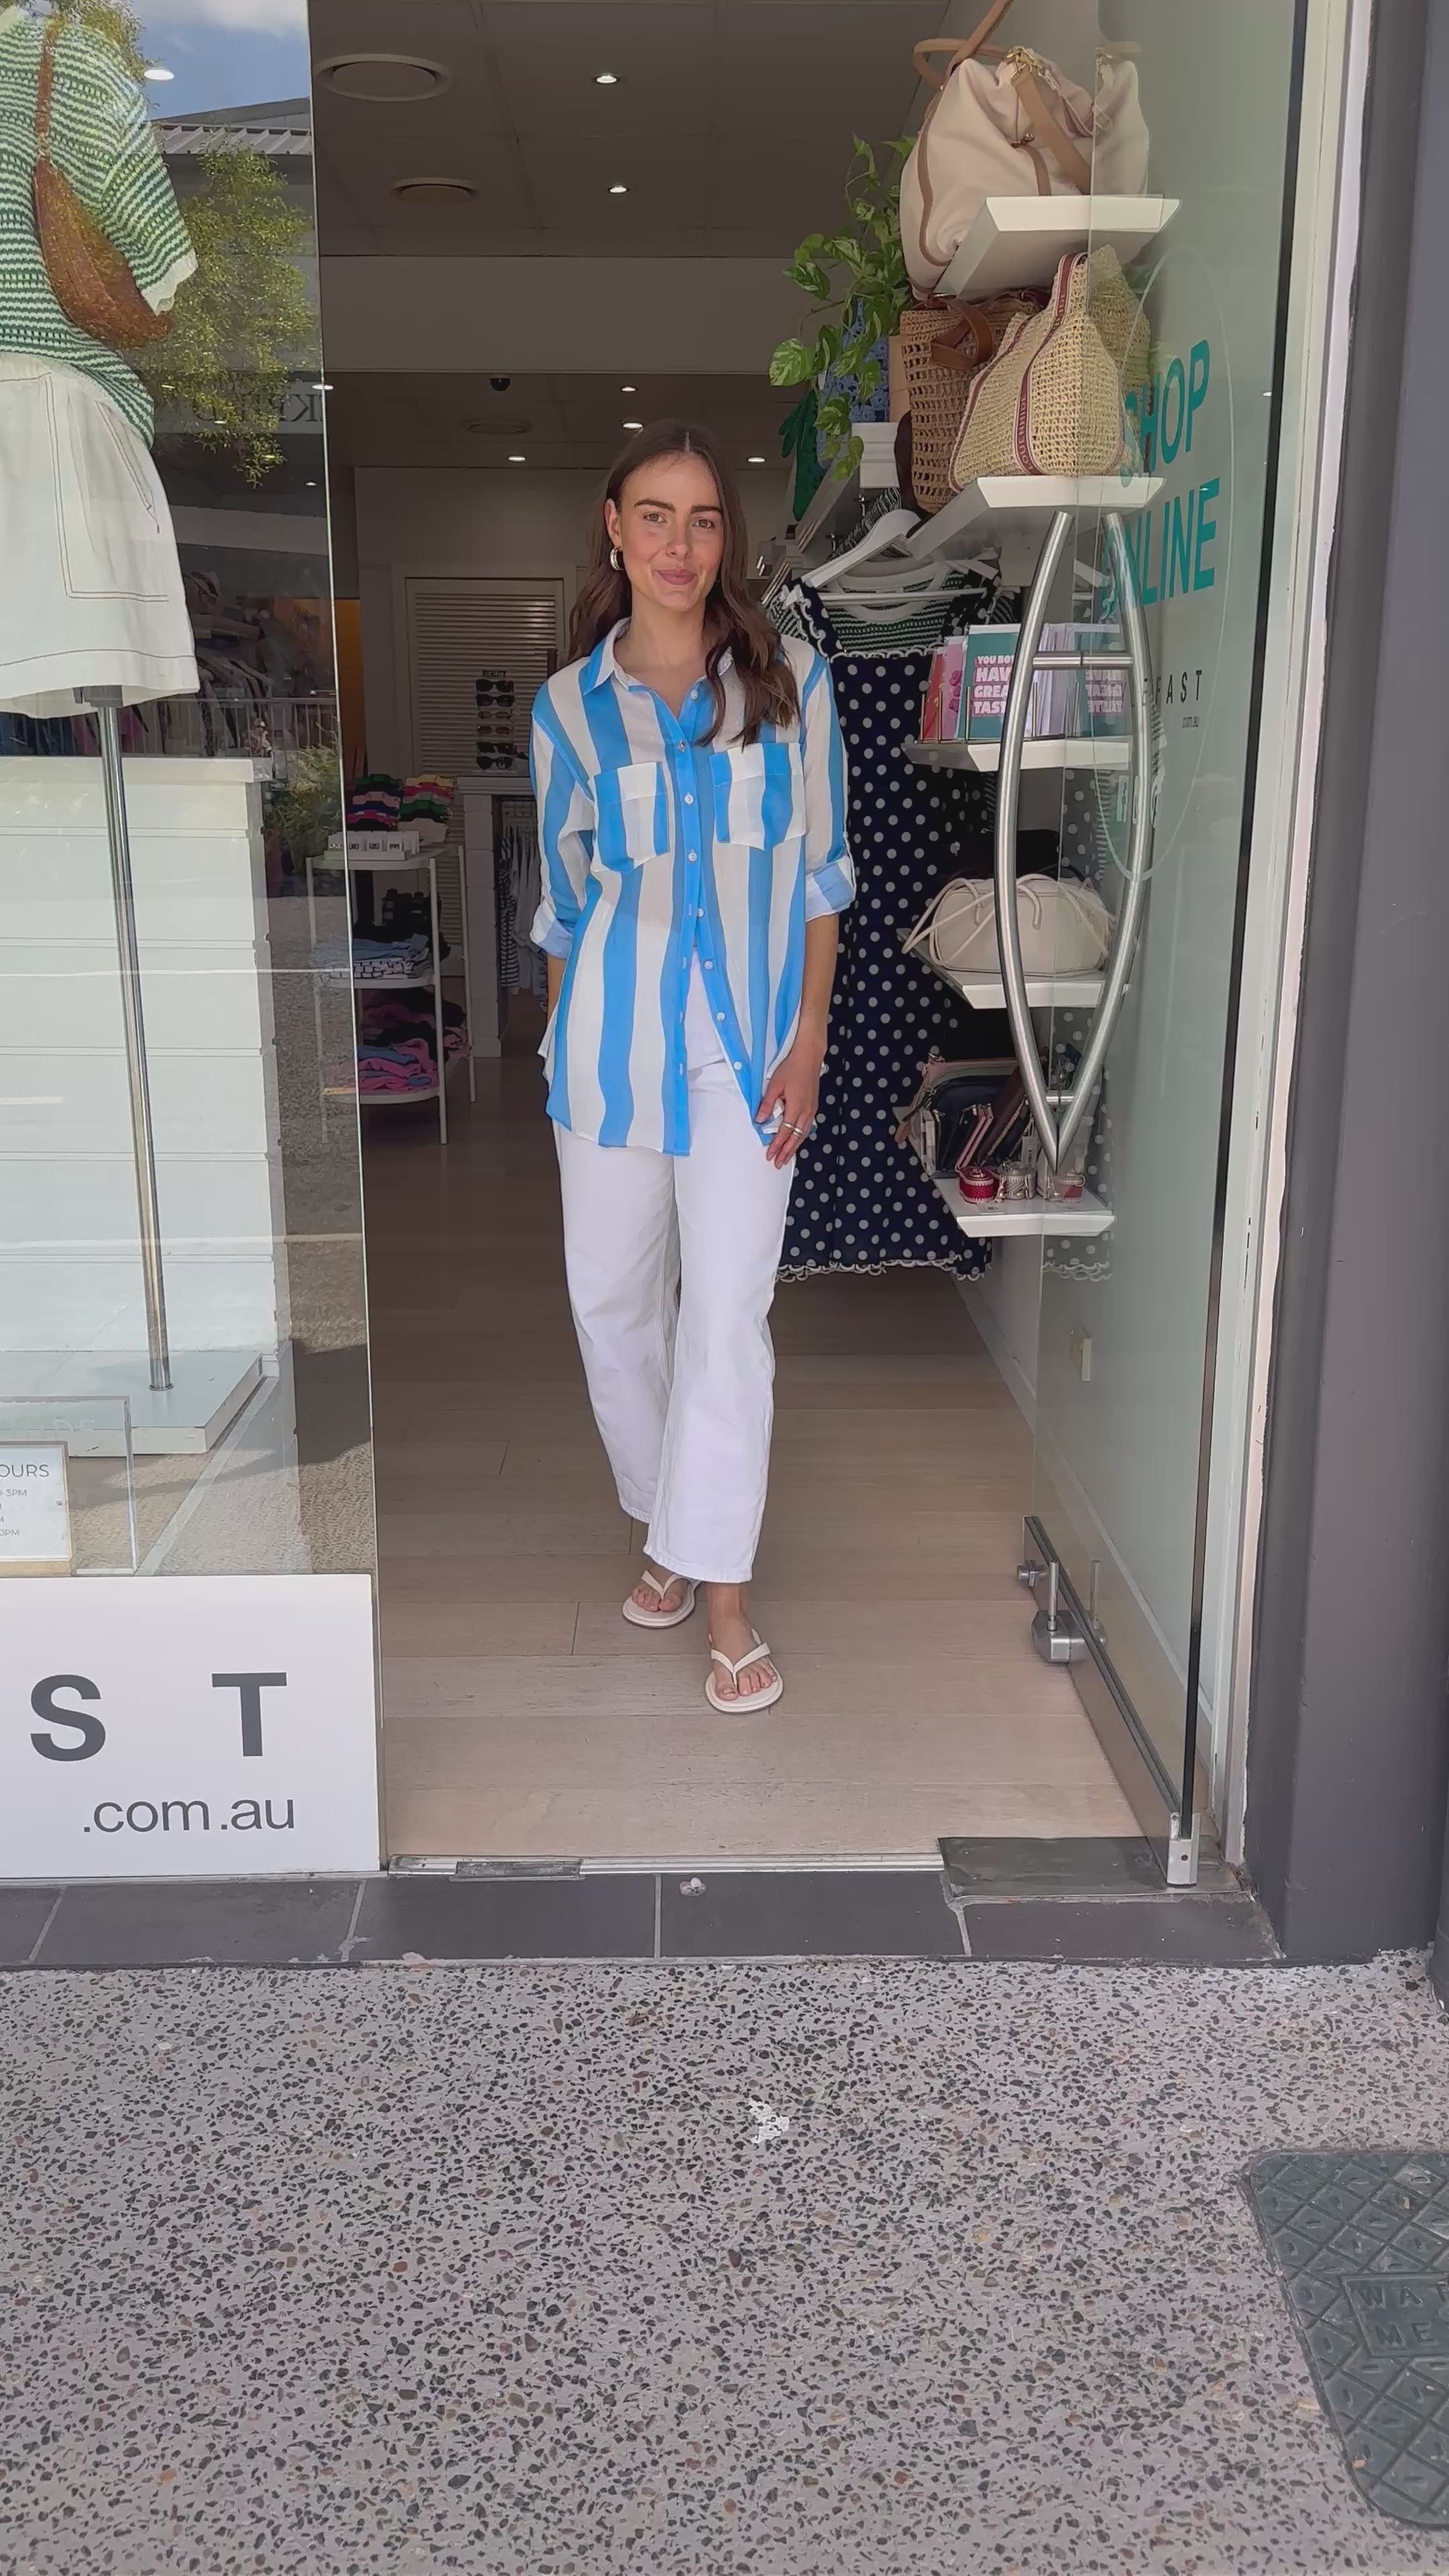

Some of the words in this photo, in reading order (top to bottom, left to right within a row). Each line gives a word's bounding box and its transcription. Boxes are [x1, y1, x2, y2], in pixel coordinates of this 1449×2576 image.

[977, 655, 997, 665] YOU
[998, 655, 1014, 664] BOT
[975, 667, 1012, 682] HAV
[973, 684, 1010, 698] GREA
[973, 700, 1006, 714] TAST
[83, 1799, 294, 1832] .com.au
